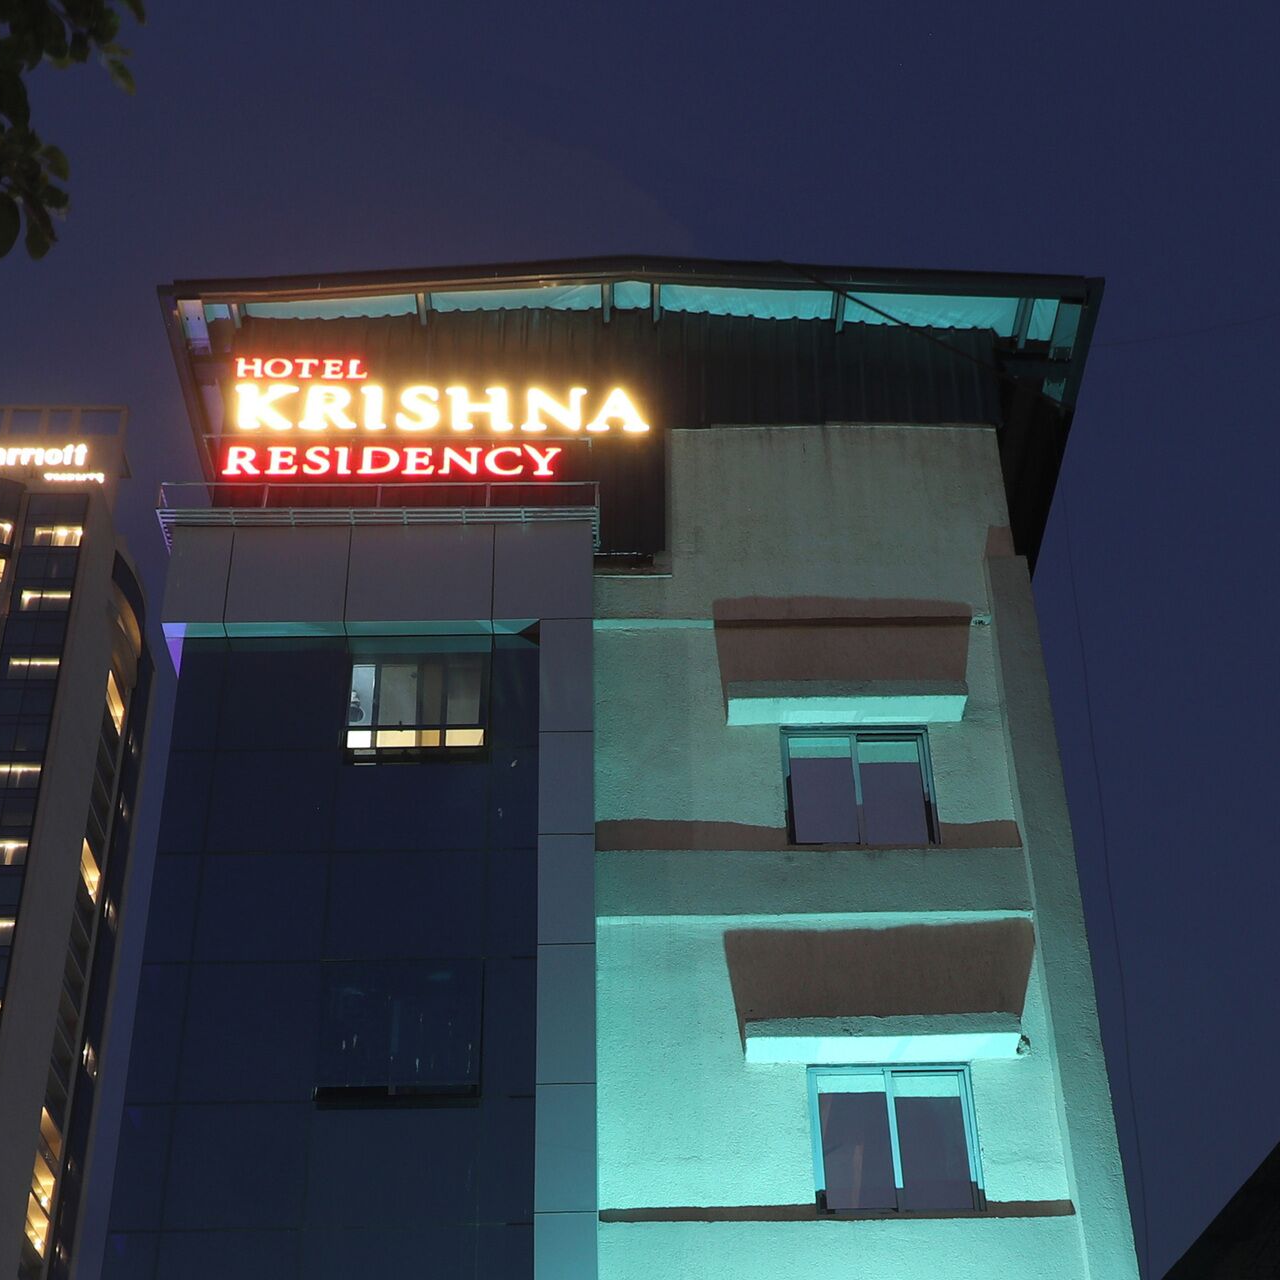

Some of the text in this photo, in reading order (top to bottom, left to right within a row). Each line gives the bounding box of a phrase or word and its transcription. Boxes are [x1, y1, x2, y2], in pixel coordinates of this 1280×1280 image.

[234, 357, 368, 380] HOTEL
[234, 383, 651, 433] KRISHNA
[221, 444, 562, 477] RESIDENCY
